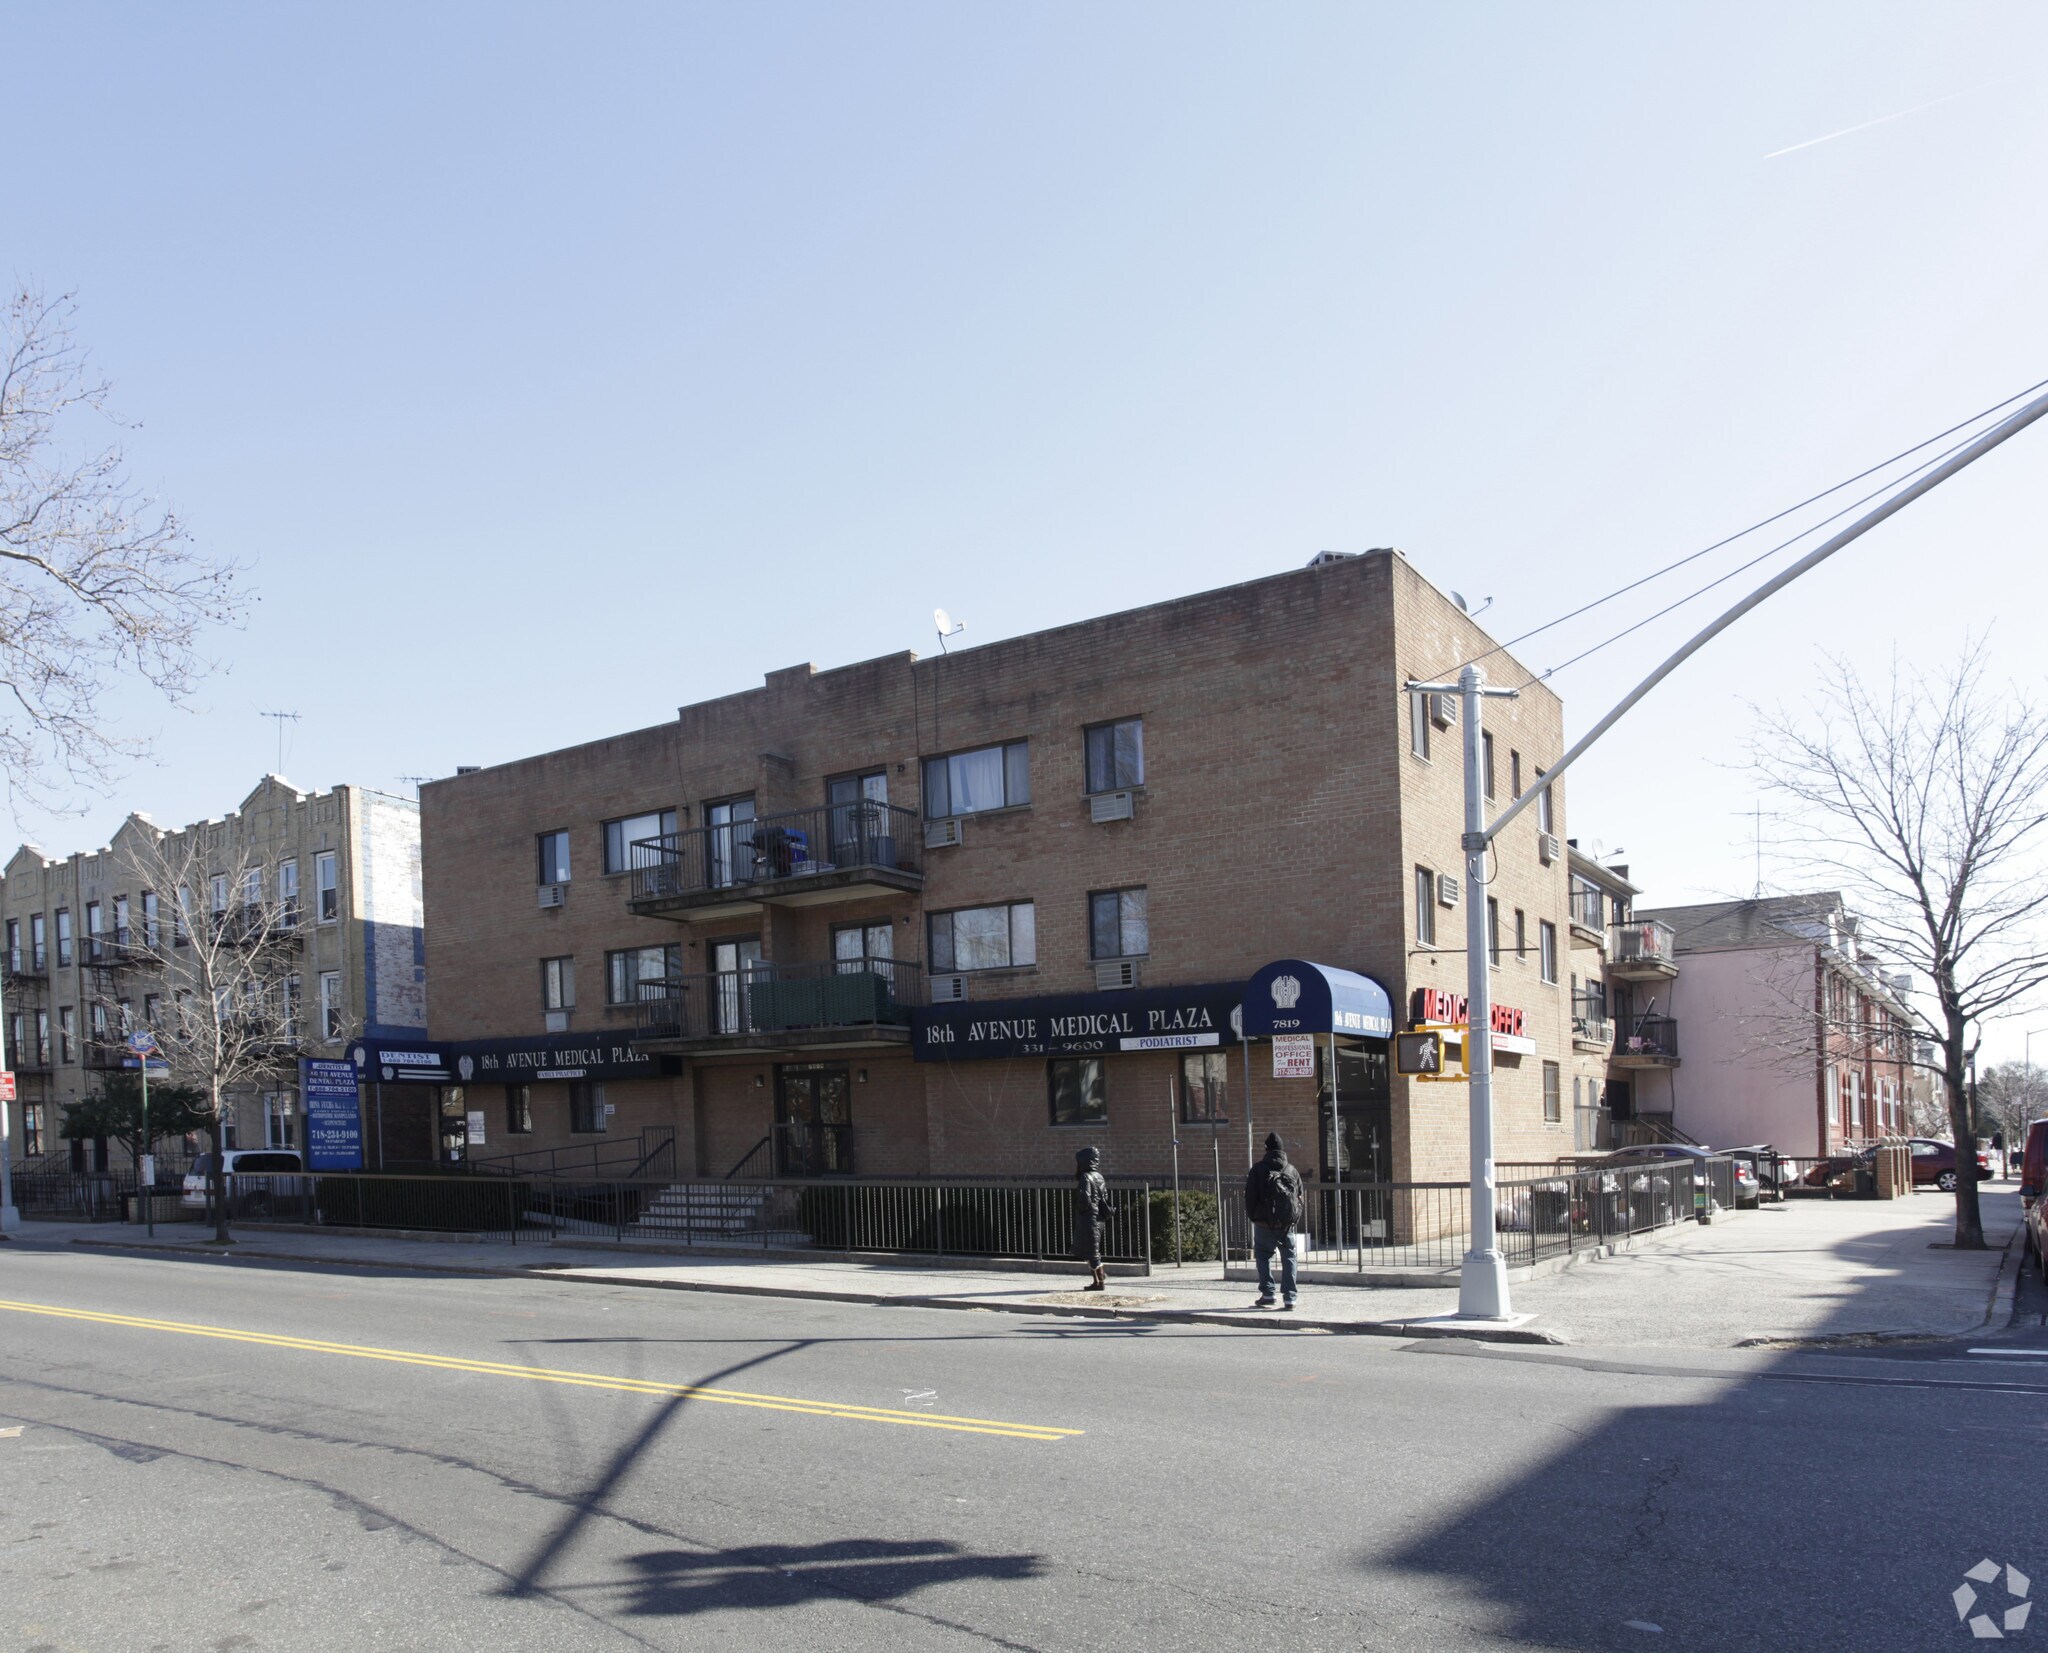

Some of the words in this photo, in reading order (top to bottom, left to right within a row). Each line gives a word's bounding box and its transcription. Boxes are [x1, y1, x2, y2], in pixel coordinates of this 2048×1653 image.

[925, 1024, 955, 1044] 18th
[968, 1018, 1037, 1042] AVENUE
[1050, 1012, 1133, 1037] MEDICAL
[1147, 1006, 1212, 1031] PLAZA
[1272, 1019, 1301, 1029] 7819
[1020, 1043, 1044, 1053] 331
[1062, 1041, 1104, 1052] 9600
[1139, 1035, 1199, 1048] PODIATRIST
[381, 1052, 429, 1060] DENTIST
[481, 1054, 500, 1070] 18th
[506, 1050, 548, 1069] AVENUE
[555, 1047, 604, 1066] MEDICAL
[1275, 1051, 1312, 1059] OFFICE
[1287, 1058, 1311, 1067] RENT
